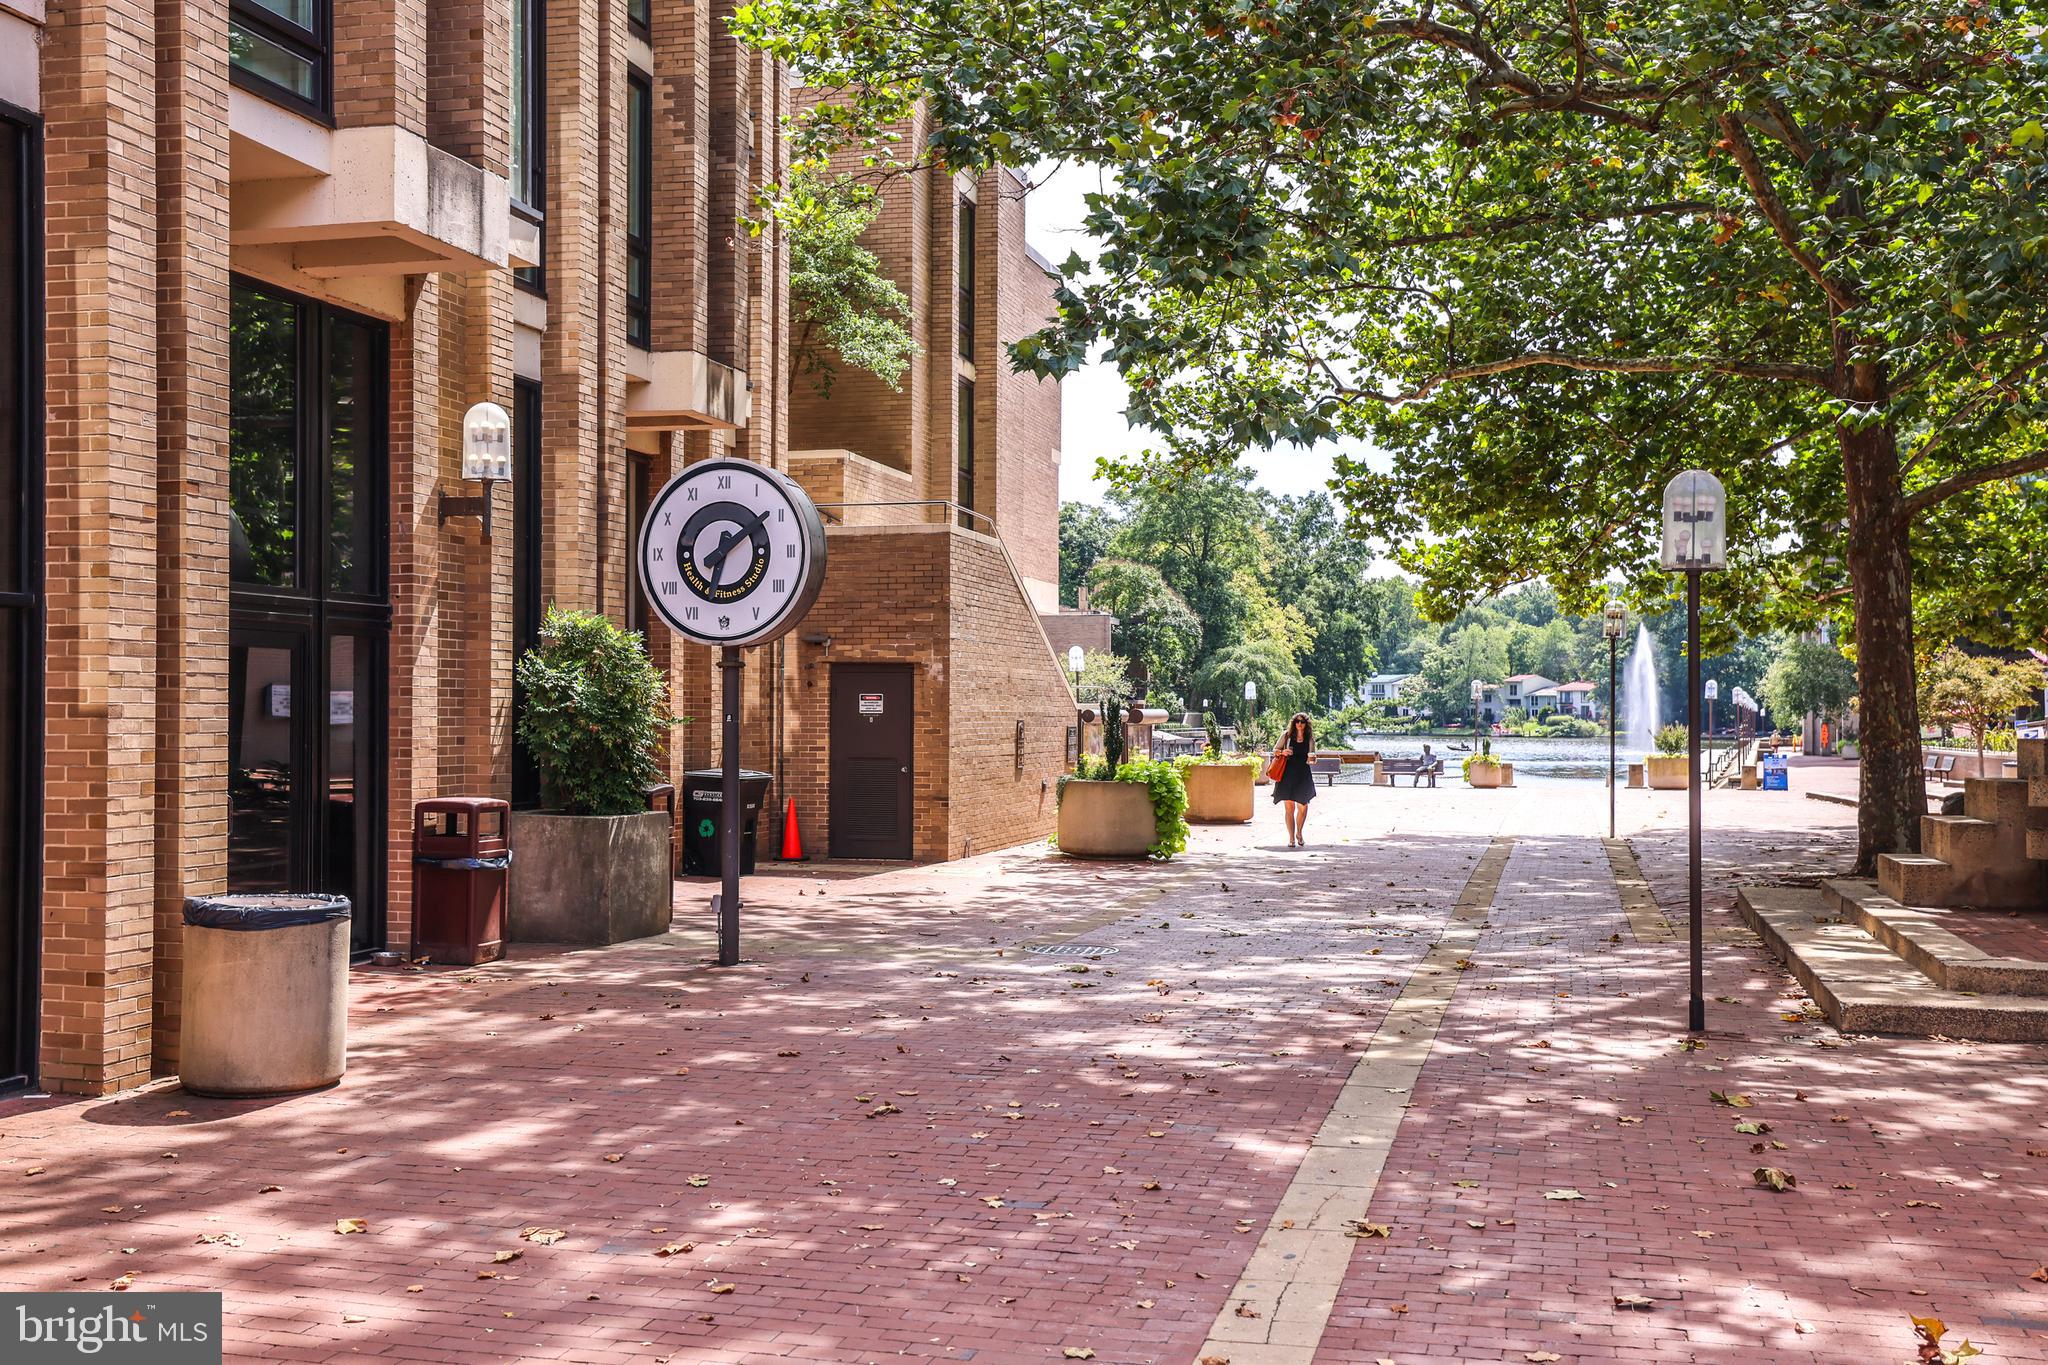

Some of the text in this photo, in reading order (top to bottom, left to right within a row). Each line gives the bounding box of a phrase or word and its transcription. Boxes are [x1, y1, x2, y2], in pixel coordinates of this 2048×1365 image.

[717, 475, 731, 490] XII
[687, 487, 698, 501] XI
[664, 512, 671, 526] X
[778, 508, 784, 523] II
[653, 547, 664, 561] IX
[786, 544, 796, 558] III
[683, 561, 704, 592] Health
[714, 587, 746, 599] Fitness
[744, 558, 765, 588] Studio
[661, 581, 678, 595] VIII
[772, 579, 785, 593] IIII
[685, 606, 699, 621] VII
[752, 606, 760, 621] V
